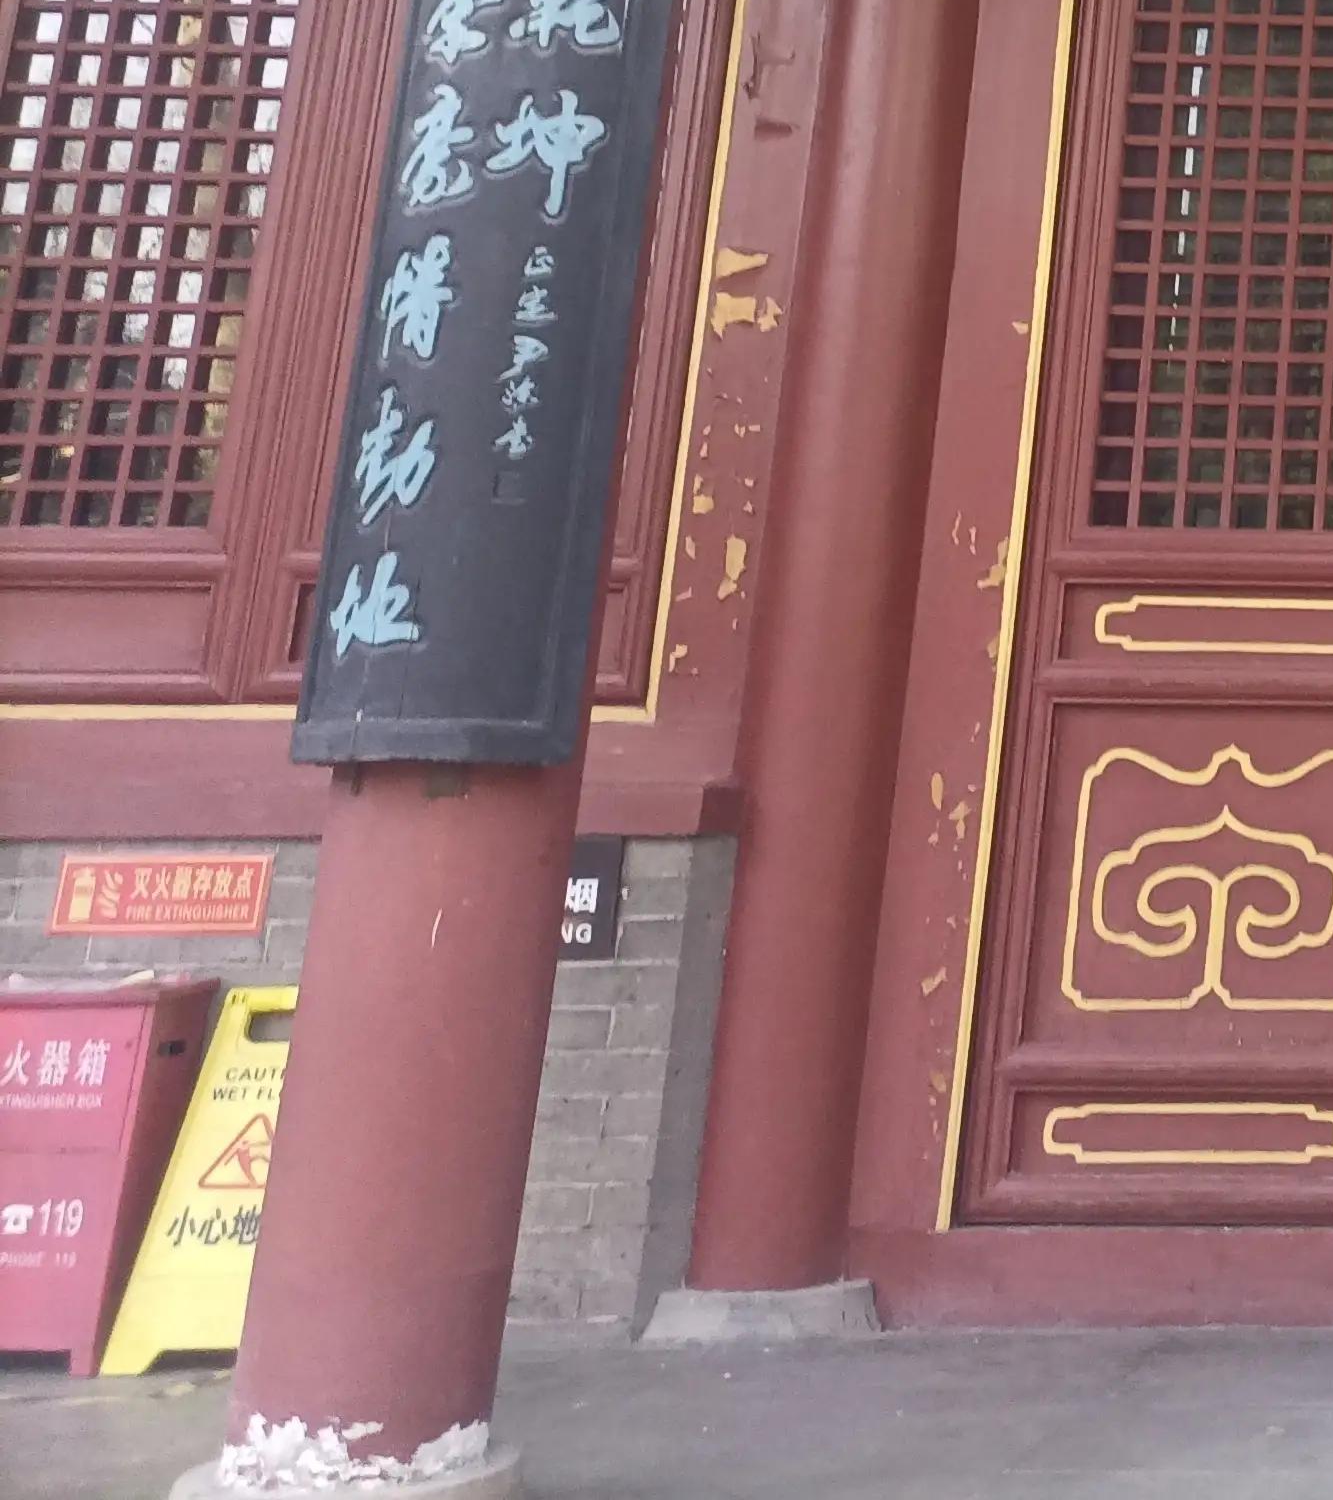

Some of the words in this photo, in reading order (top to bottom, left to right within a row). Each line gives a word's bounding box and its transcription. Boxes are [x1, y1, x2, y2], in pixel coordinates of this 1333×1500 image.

[129, 864, 255, 901] 灭火器存放点
[124, 904, 152, 922] FIRE
[212, 1086, 249, 1102] WET
[38, 1198, 84, 1238] 119
